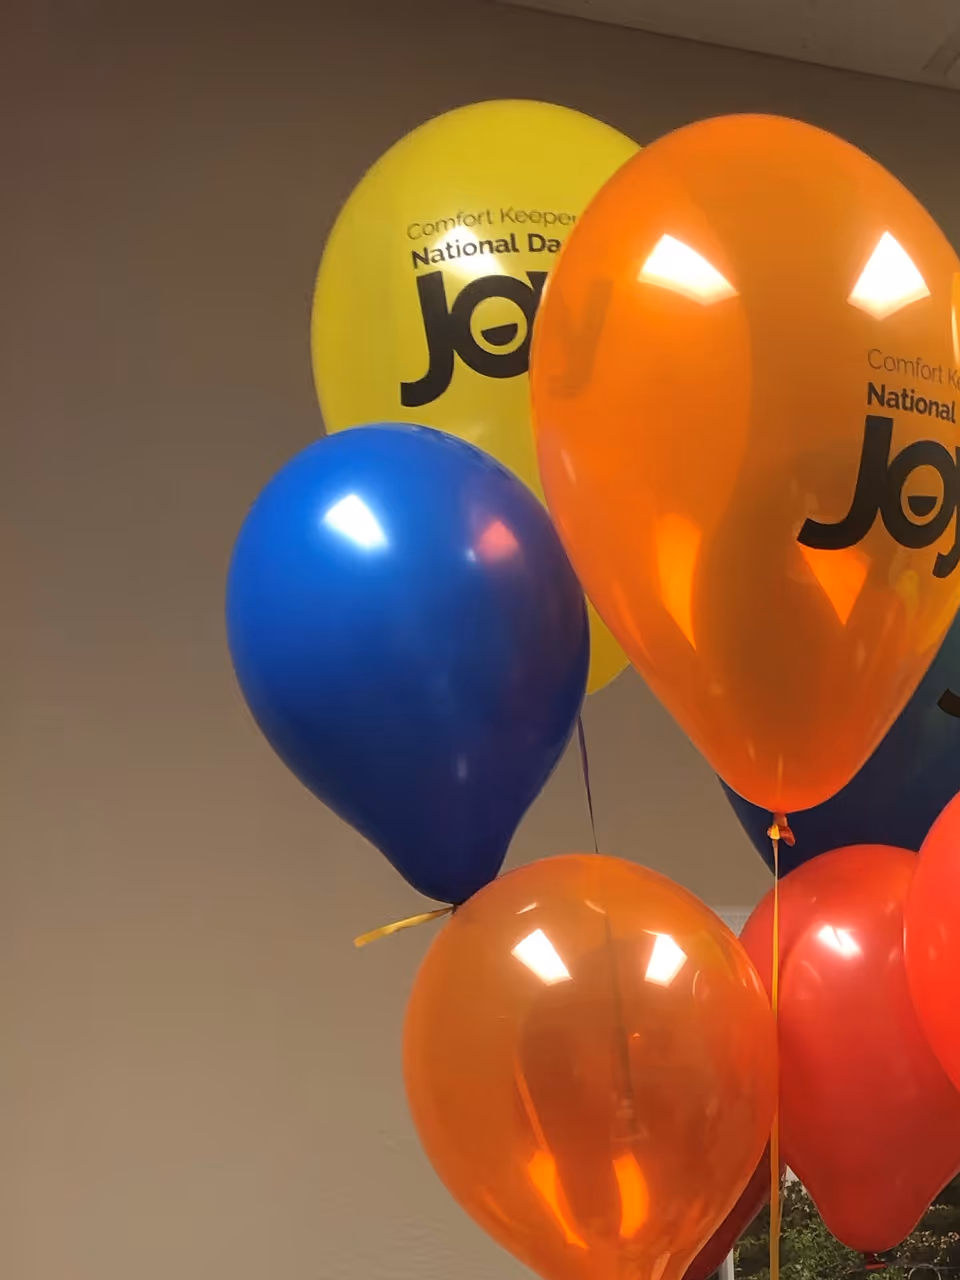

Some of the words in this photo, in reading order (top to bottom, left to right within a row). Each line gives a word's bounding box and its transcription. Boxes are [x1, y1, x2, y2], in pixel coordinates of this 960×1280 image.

[407, 209, 493, 240] Comfort
[500, 206, 576, 227] Keeper
[411, 233, 520, 269] National
[528, 233, 563, 253] Da
[867, 349, 943, 384] Comfort
[867, 382, 956, 423] National
